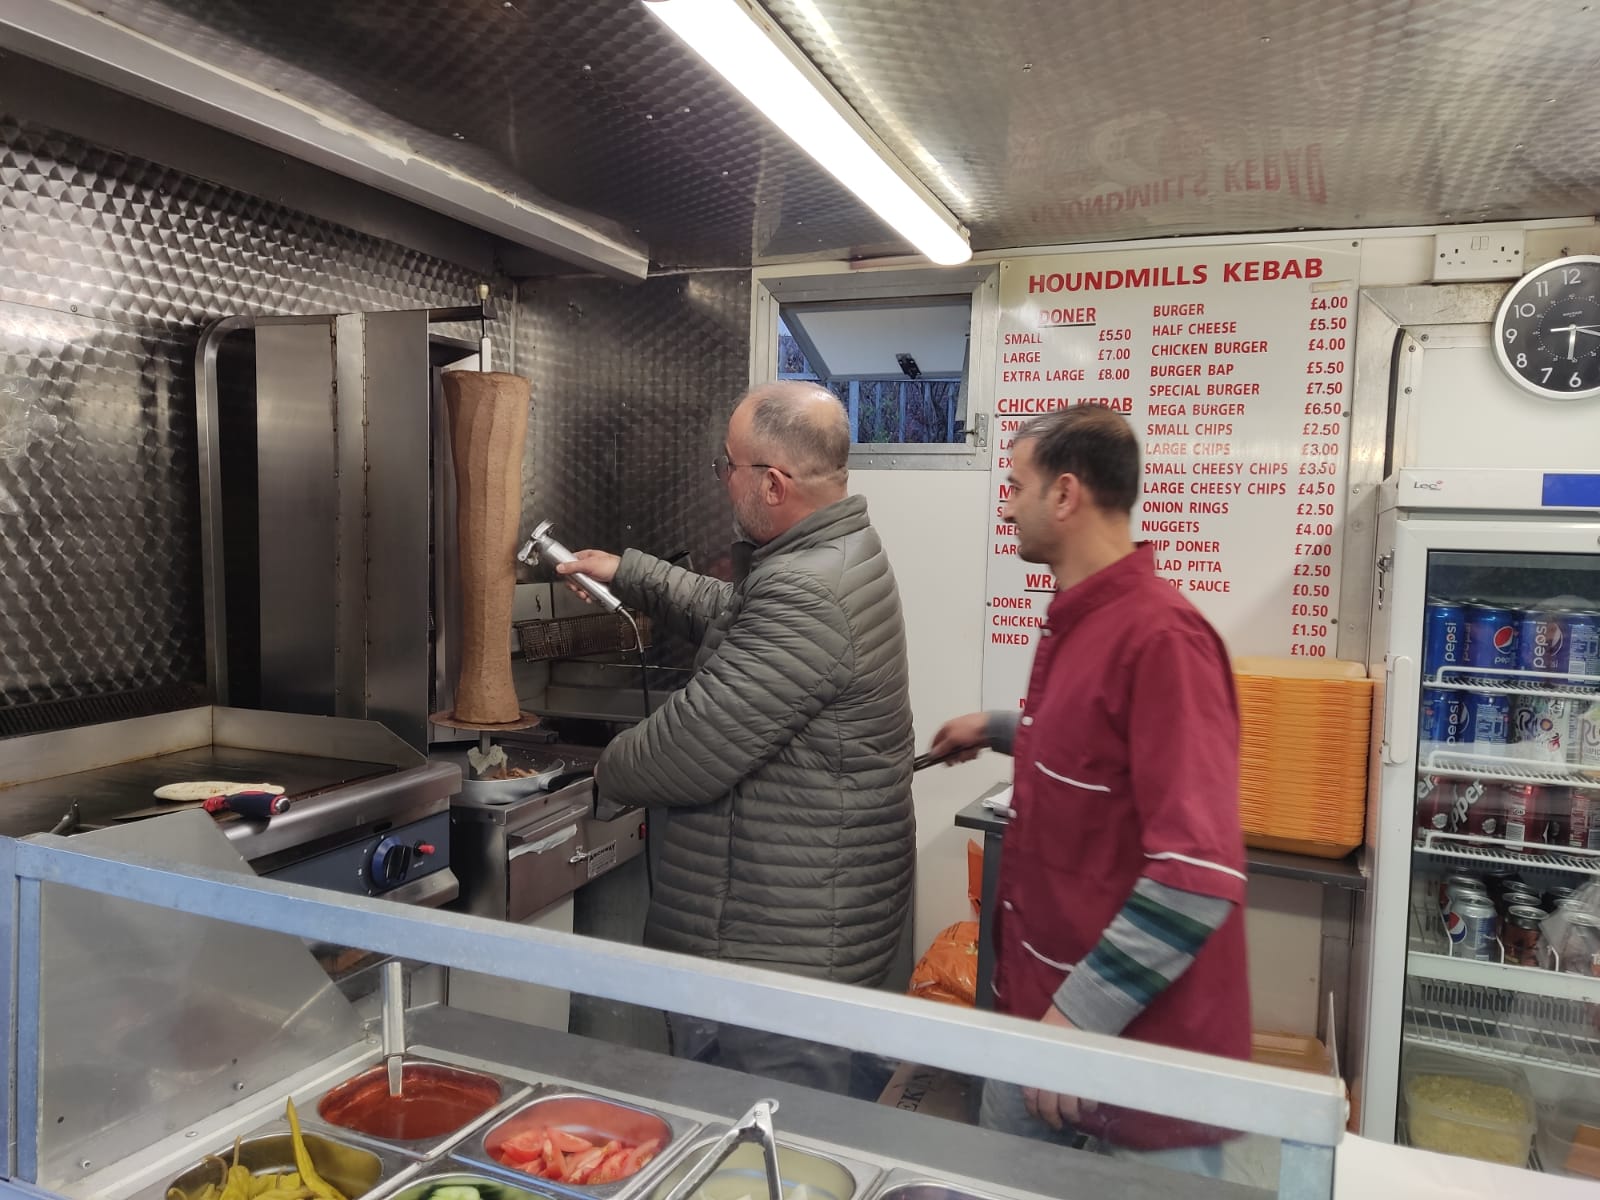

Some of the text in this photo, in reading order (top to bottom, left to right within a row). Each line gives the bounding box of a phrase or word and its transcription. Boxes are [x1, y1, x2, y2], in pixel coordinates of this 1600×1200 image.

[1029, 258, 1323, 294] HOUNDMILLS KEBAB
[1561, 268, 1582, 285] 12
[1536, 280, 1549, 297] 11
[1153, 296, 1348, 317] BURGER £4.00
[1513, 302, 1536, 319] 10
[1040, 307, 1096, 325] DONER
[1152, 317, 1347, 337] HALF CHEESE £5.50
[1004, 333, 1043, 345] SMALL
[1505, 328, 1518, 344] 9
[1003, 348, 1130, 363] LARGE £7.00
[1151, 338, 1346, 357] CHICKEN BURGER £4.00
[1516, 352, 1528, 368] 8
[1003, 368, 1130, 382] EXTRA LARGE £8.00
[1150, 361, 1344, 377] BURGER BAP £5.50
[1540, 367, 1553, 384] 7
[1569, 371, 1582, 388] 6
[1149, 382, 1343, 397] SPECIAL BURGER £7.50
[997, 398, 1069, 414] CHICKEN
[1148, 402, 1342, 416] MEGA BURGER £6.50
[1147, 422, 1340, 436] SMALL CHIPS £2.50
[1145, 443, 1338, 456] LARGE CHIPS £3.00
[1145, 462, 1336, 475] SMALL CHEESY CHIPS £3.50
[1143, 481, 1335, 496] LARGE CHEESY CHIPS £4.50
[1143, 501, 1334, 516] ONION RINGS £2.50
[1141, 521, 1333, 536] NUGGETS £4.00
[1143, 540, 1331, 556] HIP DONER £7.00
[1188, 560, 1222, 573] PITTA
[1293, 564, 1331, 577] £2.50
[1189, 579, 1230, 593] SAUCE
[1292, 584, 1330, 597] £0.50
[992, 597, 1032, 609] DONER
[1291, 604, 1328, 617] £0.50
[992, 615, 1043, 628] CHICKEN
[991, 632, 1030, 645] MIXED
[1292, 624, 1327, 637] £1.50
[1445, 622, 1457, 662] pepsi
[1533, 621, 1548, 669] pepsi
[1290, 644, 1326, 657] £1.00
[1447, 700, 1460, 747] pepsi
